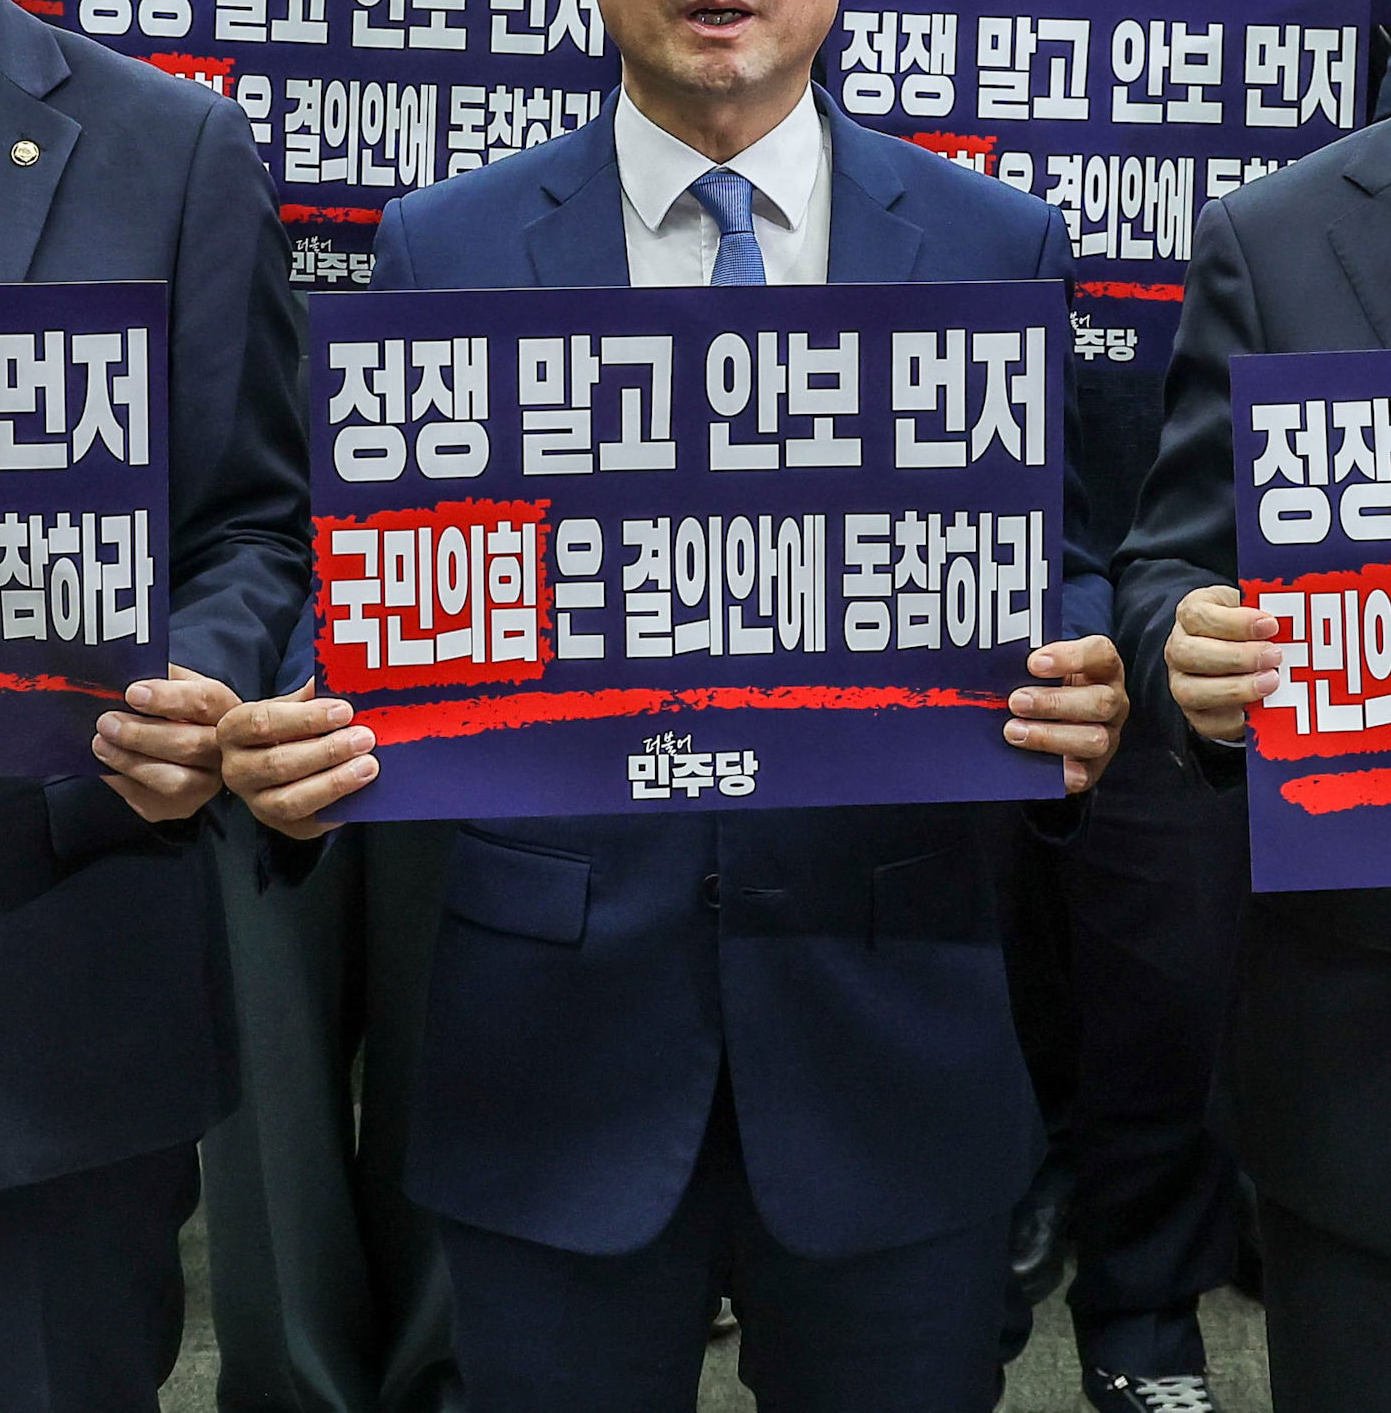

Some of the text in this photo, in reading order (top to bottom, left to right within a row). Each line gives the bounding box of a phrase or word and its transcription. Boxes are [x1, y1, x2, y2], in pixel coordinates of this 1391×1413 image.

[840, 11, 1360, 129] 정쟁 말고 안보 먼저
[284, 78, 437, 188] 결의안에
[295, 236, 332, 254] 더불어
[1046, 154, 1194, 261] 결의안에
[289, 250, 375, 284] 민주당
[1073, 328, 1137, 361] 주당
[328, 326, 1048, 483] 정쟁 말고 안보 먼저
[329, 510, 1049, 670] 국민의힘 은 결의안에 동참하라
[626, 750, 759, 799] 민주당
[641, 733, 694, 755] 더불어
